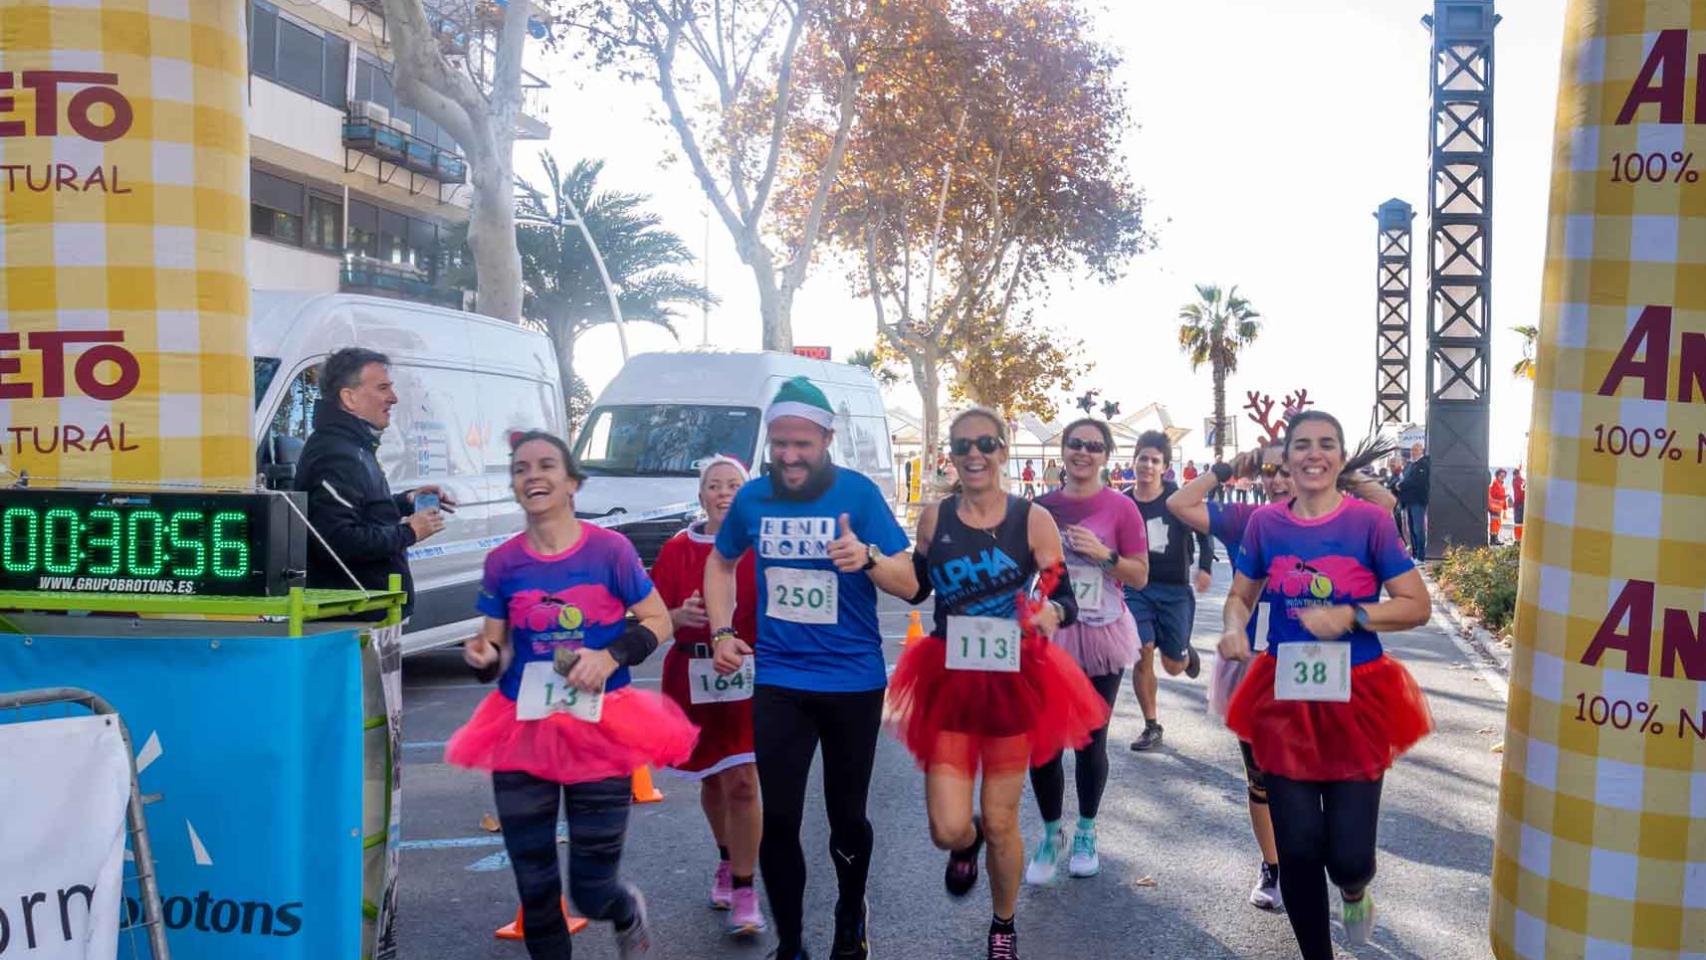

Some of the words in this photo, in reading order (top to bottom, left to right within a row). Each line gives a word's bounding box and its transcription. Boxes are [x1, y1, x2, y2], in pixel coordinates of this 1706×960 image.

[1615, 29, 1706, 125] A
[0, 163, 132, 194] TURAL
[1610, 151, 1699, 183] 100%
[0, 422, 139, 455] TURAL
[1593, 423, 1682, 461] 100%
[3, 508, 248, 577] 00:30:56
[39, 576, 194, 594] WWW.GRUPOBROTONS.ES
[776, 584, 824, 608] 250
[961, 636, 1008, 659] 113
[701, 672, 744, 692] 164
[1294, 661, 1327, 684] 38
[1574, 692, 1663, 735] 100%
[121, 890, 303, 937] otons
